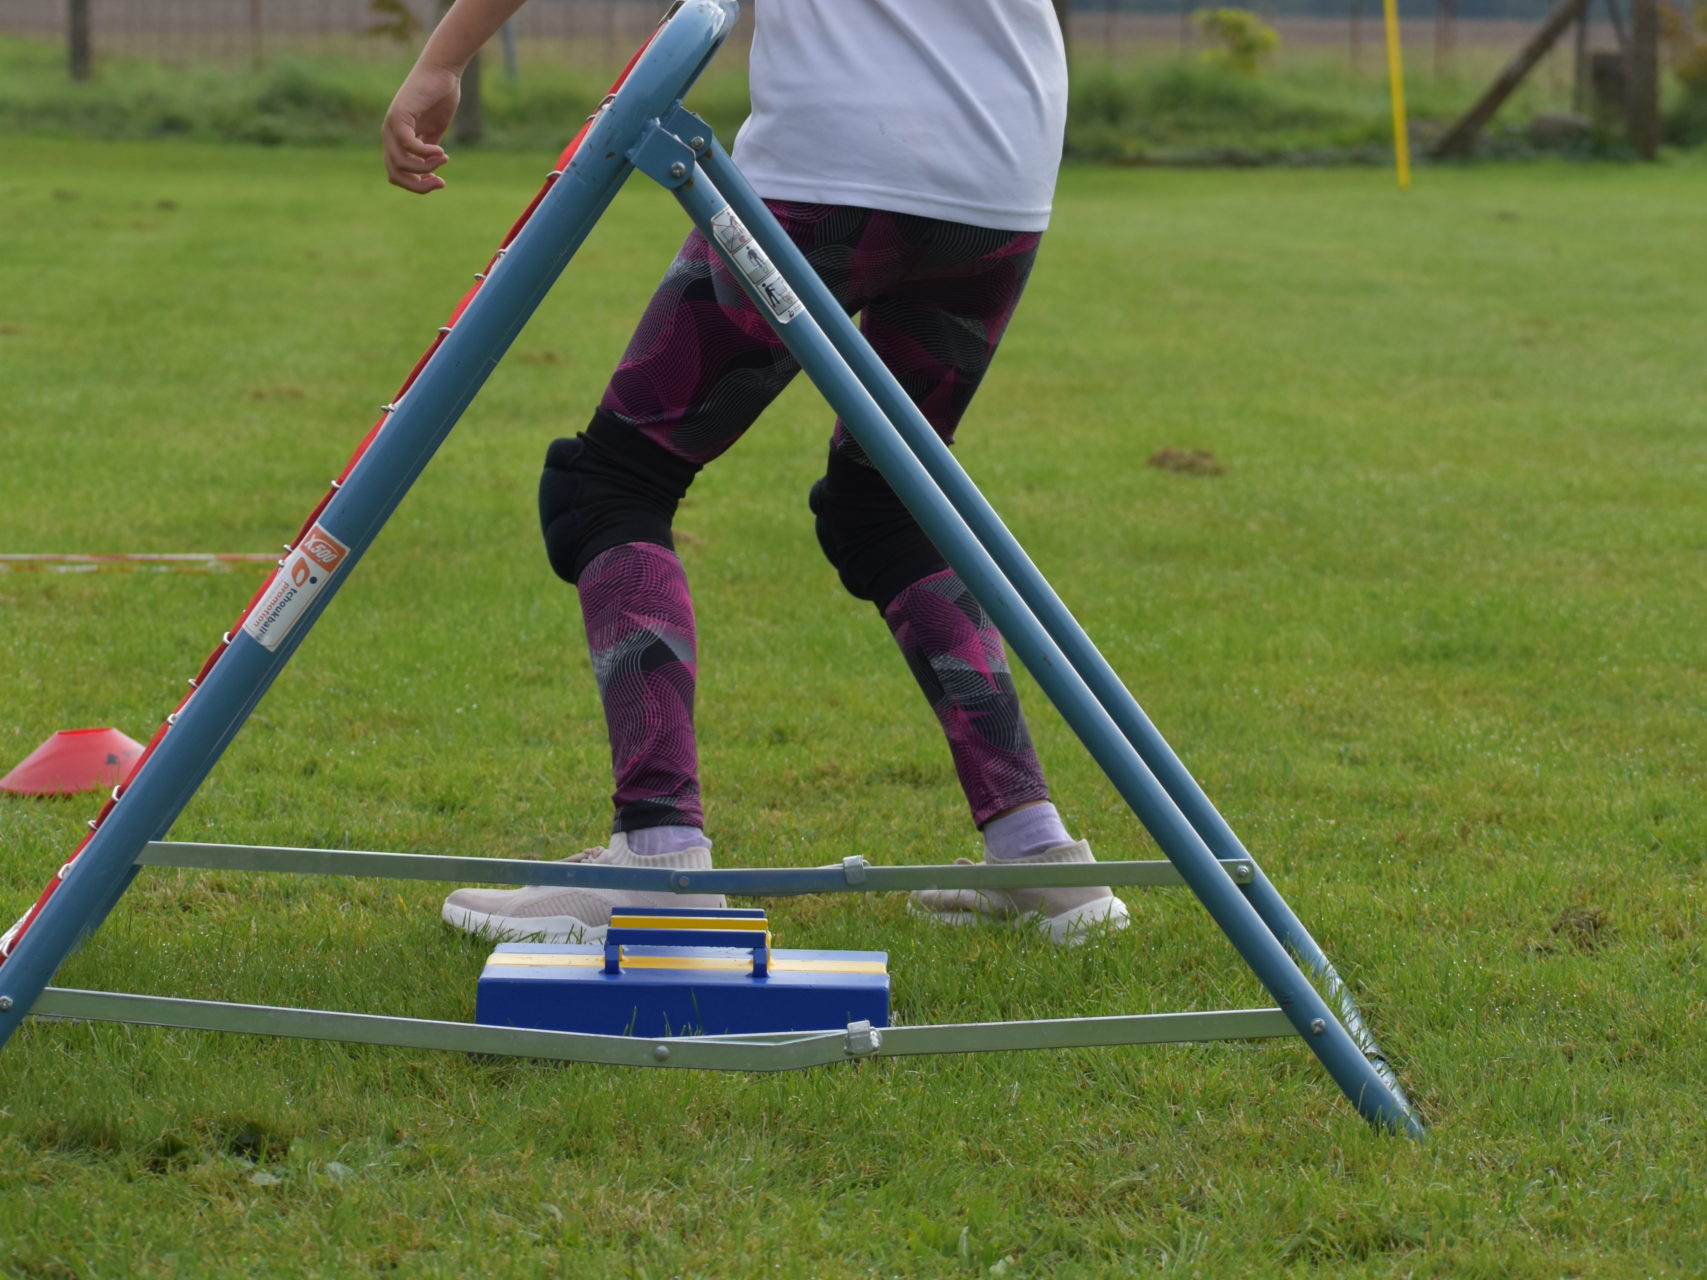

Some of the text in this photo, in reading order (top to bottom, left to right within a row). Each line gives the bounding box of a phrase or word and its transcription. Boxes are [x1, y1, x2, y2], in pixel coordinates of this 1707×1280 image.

[305, 534, 337, 563] X500
[254, 582, 290, 627] promotion
[261, 588, 297, 634] tchoukball
